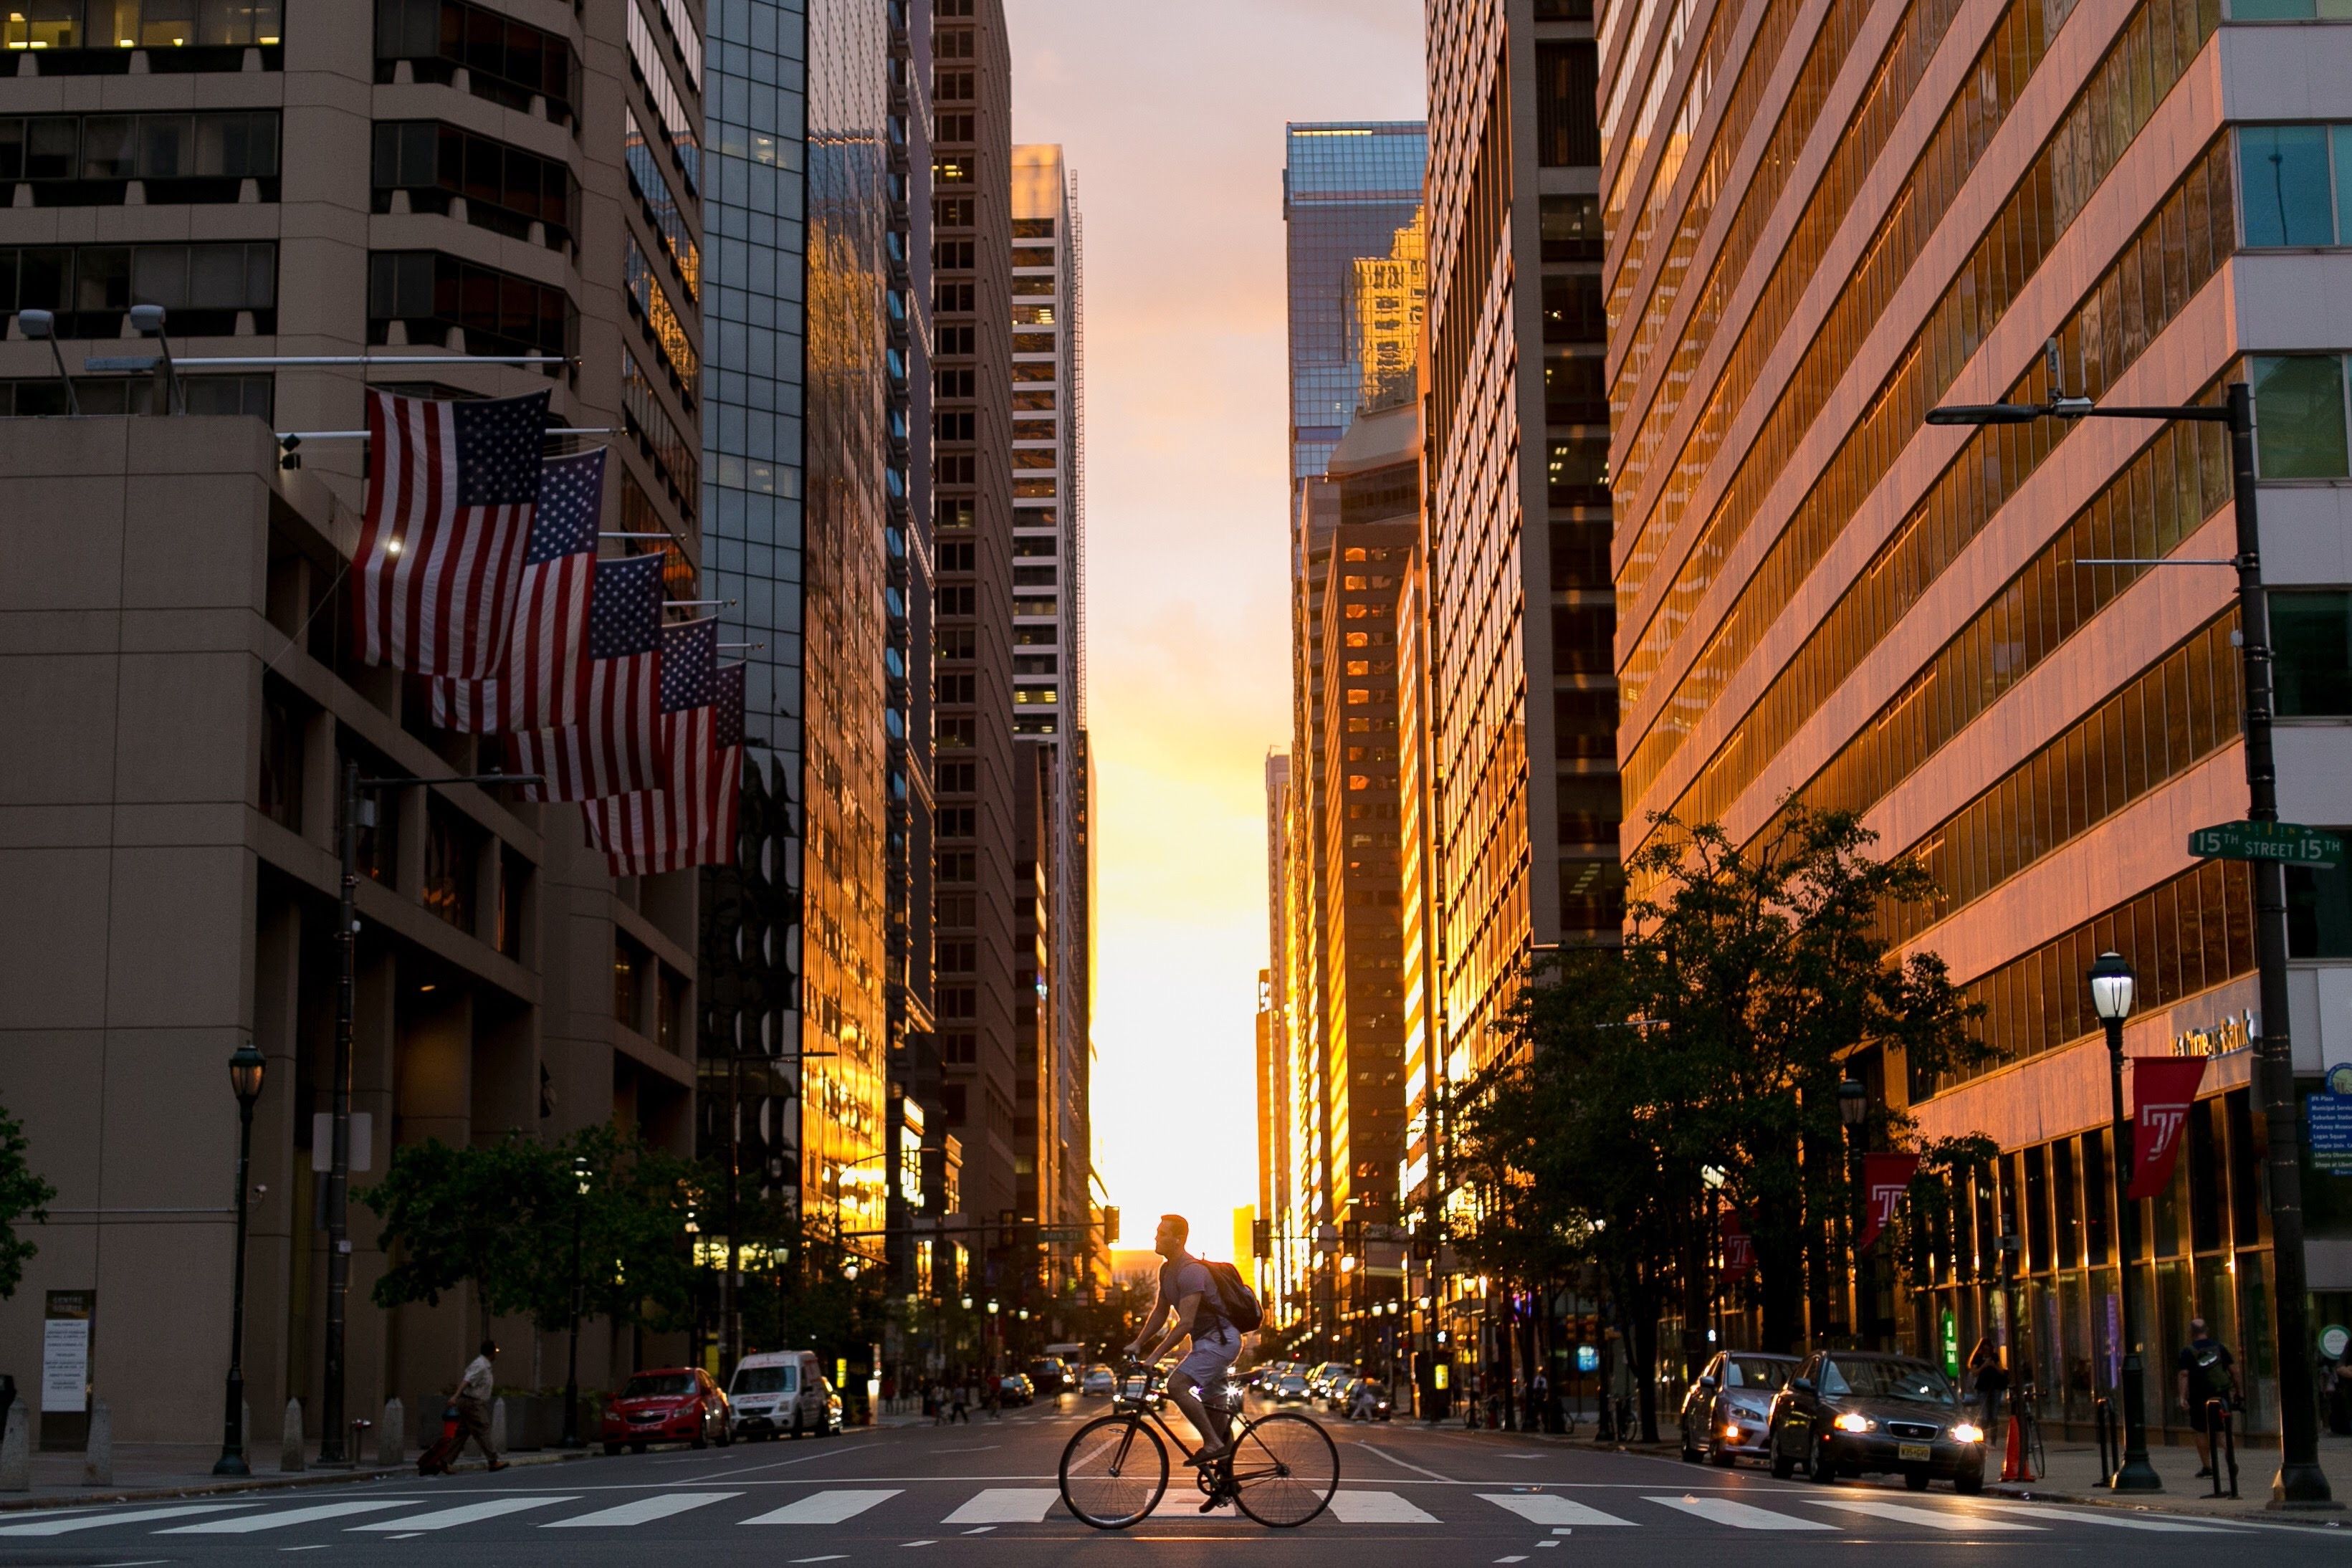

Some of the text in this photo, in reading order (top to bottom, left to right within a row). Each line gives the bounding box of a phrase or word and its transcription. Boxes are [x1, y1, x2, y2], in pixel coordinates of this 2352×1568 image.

[2199, 832, 2341, 860] 15TH STREET 15TH
[2219, 1008, 2253, 1054] Bank
